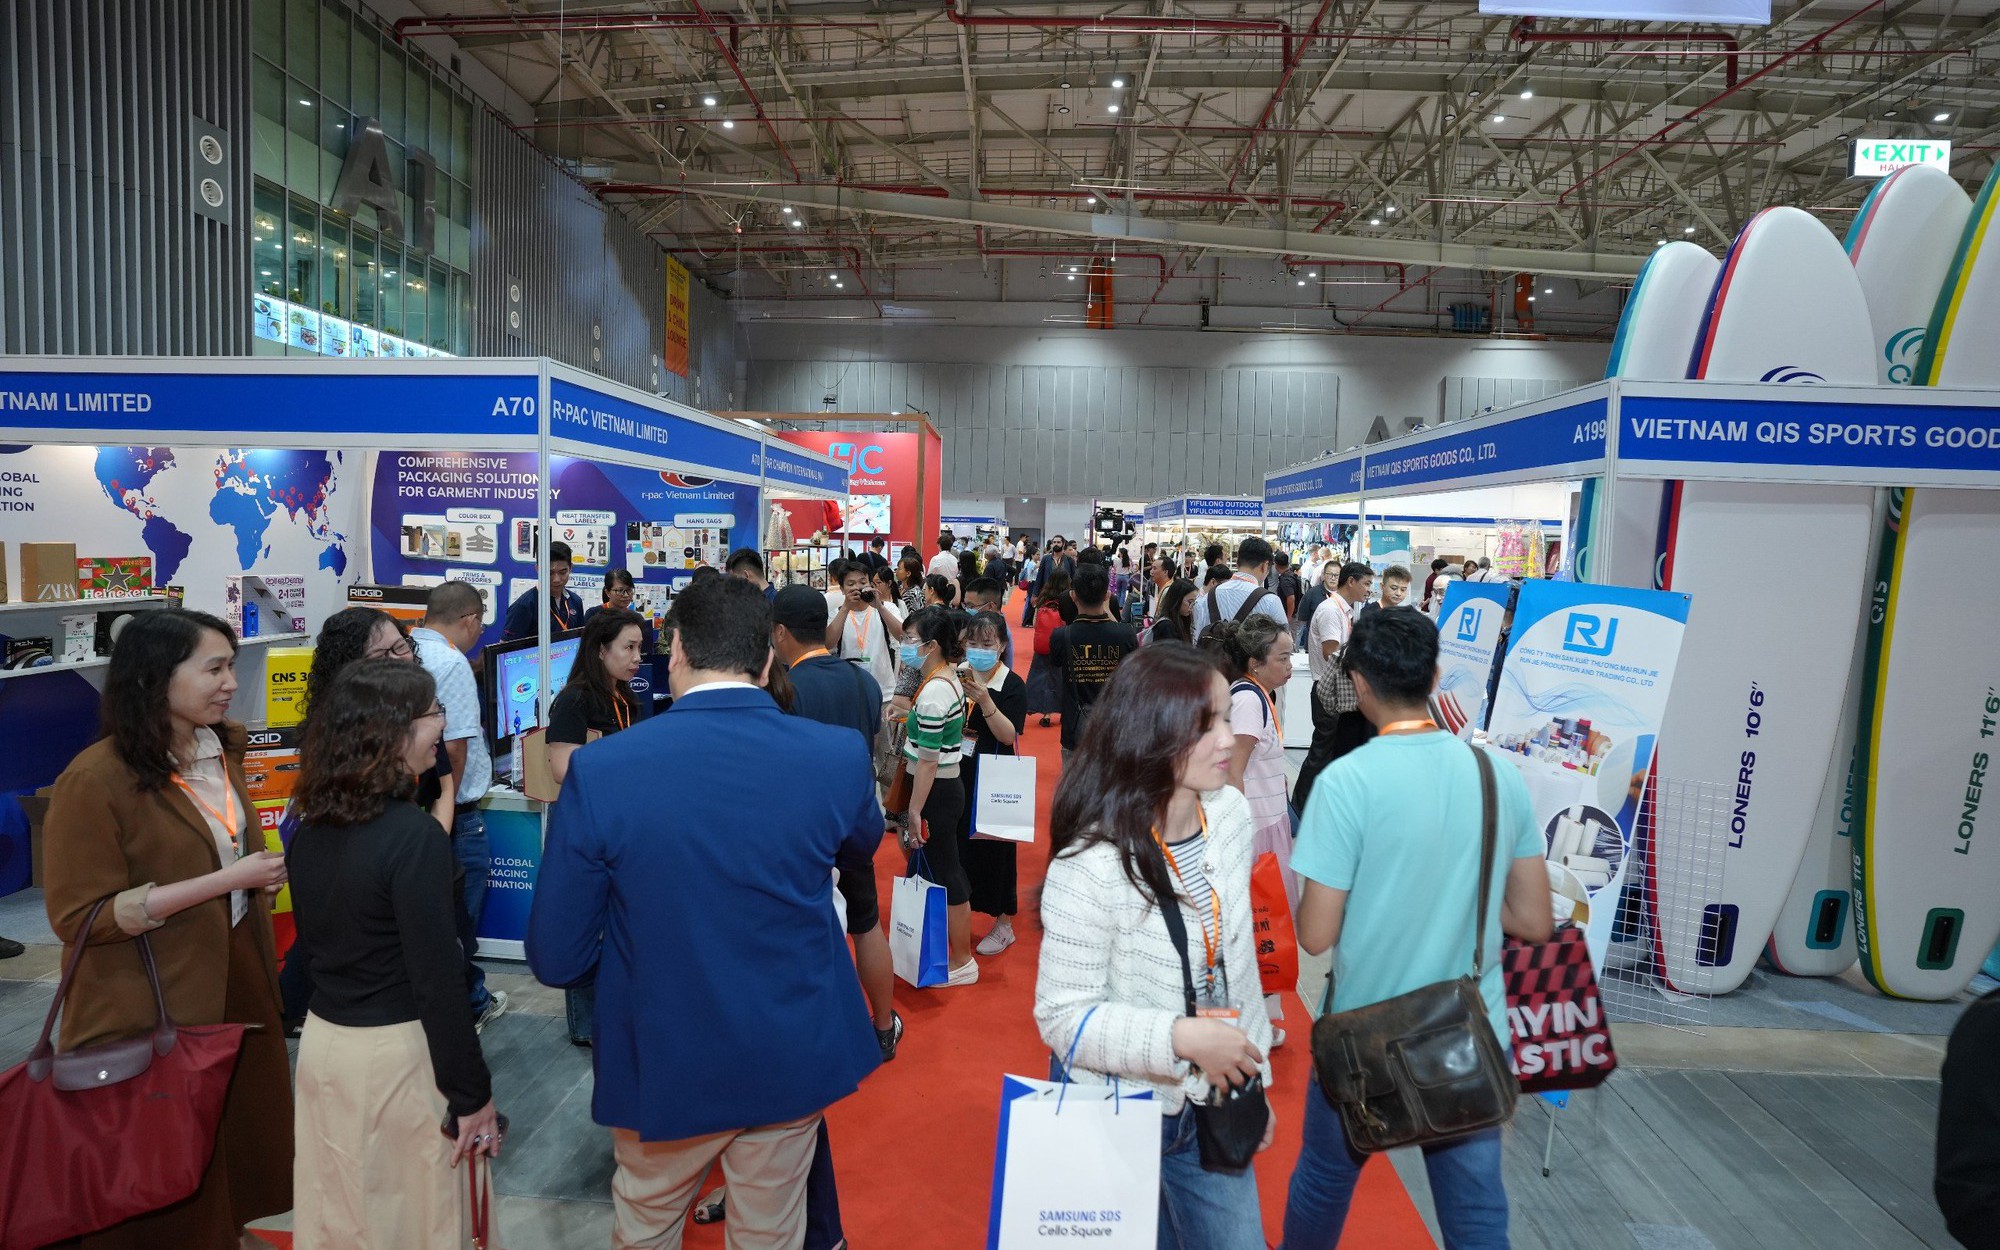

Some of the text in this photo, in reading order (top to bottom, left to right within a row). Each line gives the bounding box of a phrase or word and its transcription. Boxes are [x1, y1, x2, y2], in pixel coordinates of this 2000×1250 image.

[1874, 144, 1931, 162] EXIT
[65, 393, 152, 413] LIMITED
[492, 396, 535, 416] A70
[553, 399, 668, 445] R-PAC VIETNAM LIMITED
[1574, 419, 1607, 444] A199
[1631, 417, 1748, 442] VIETNAM
[1755, 421, 1800, 445] QIS
[1808, 423, 1917, 447] SPORTS
[398, 457, 507, 470] COMPREHENSIVE
[1366, 459, 1390, 479] VIETNAM
[1390, 457, 1402, 475] QIS
[1402, 454, 1429, 473] SPORTS
[1430, 449, 1458, 468] GOODS
[1478, 443, 1497, 460] LTD.
[0, 472, 40, 483] OBAL
[398, 471, 472, 484] PACKAGING
[398, 486, 423, 498] FOR
[427, 487, 490, 499] GARMENT
[641, 490, 734, 500] r-pac Vietnam Limited
[0, 502, 35, 511] TION
[1225, 500, 1260, 508] OUTDOOR
[84, 588, 149, 599] Heineken
[349, 589, 383, 598] RIDGID
[1869, 580, 1888, 625] QIS
[1457, 607, 1482, 642] RJ
[1563, 612, 1619, 656] RJ
[272, 672, 296, 682] CNS
[1540, 660, 1581, 673] PRODUCTION
[1581, 667, 1594, 676] AND
[1595, 670, 1625, 681] TRADING
[1640, 678, 1653, 687] LTD
[1633, 667, 1647, 676] RUN
[1728, 750, 1756, 849] LONERS
[1954, 751, 1989, 856] LONERS
[494, 857, 534, 868] GLOBAL
[490, 868, 528, 878] KAGING
[487, 880, 533, 890] TINATION
[1854, 888, 1867, 953] LONERS
[1512, 1033, 1609, 1075] STIC
[1039, 1210, 1122, 1222] SAMSUNG SDS
[1038, 1225, 1112, 1237] Cello Square
